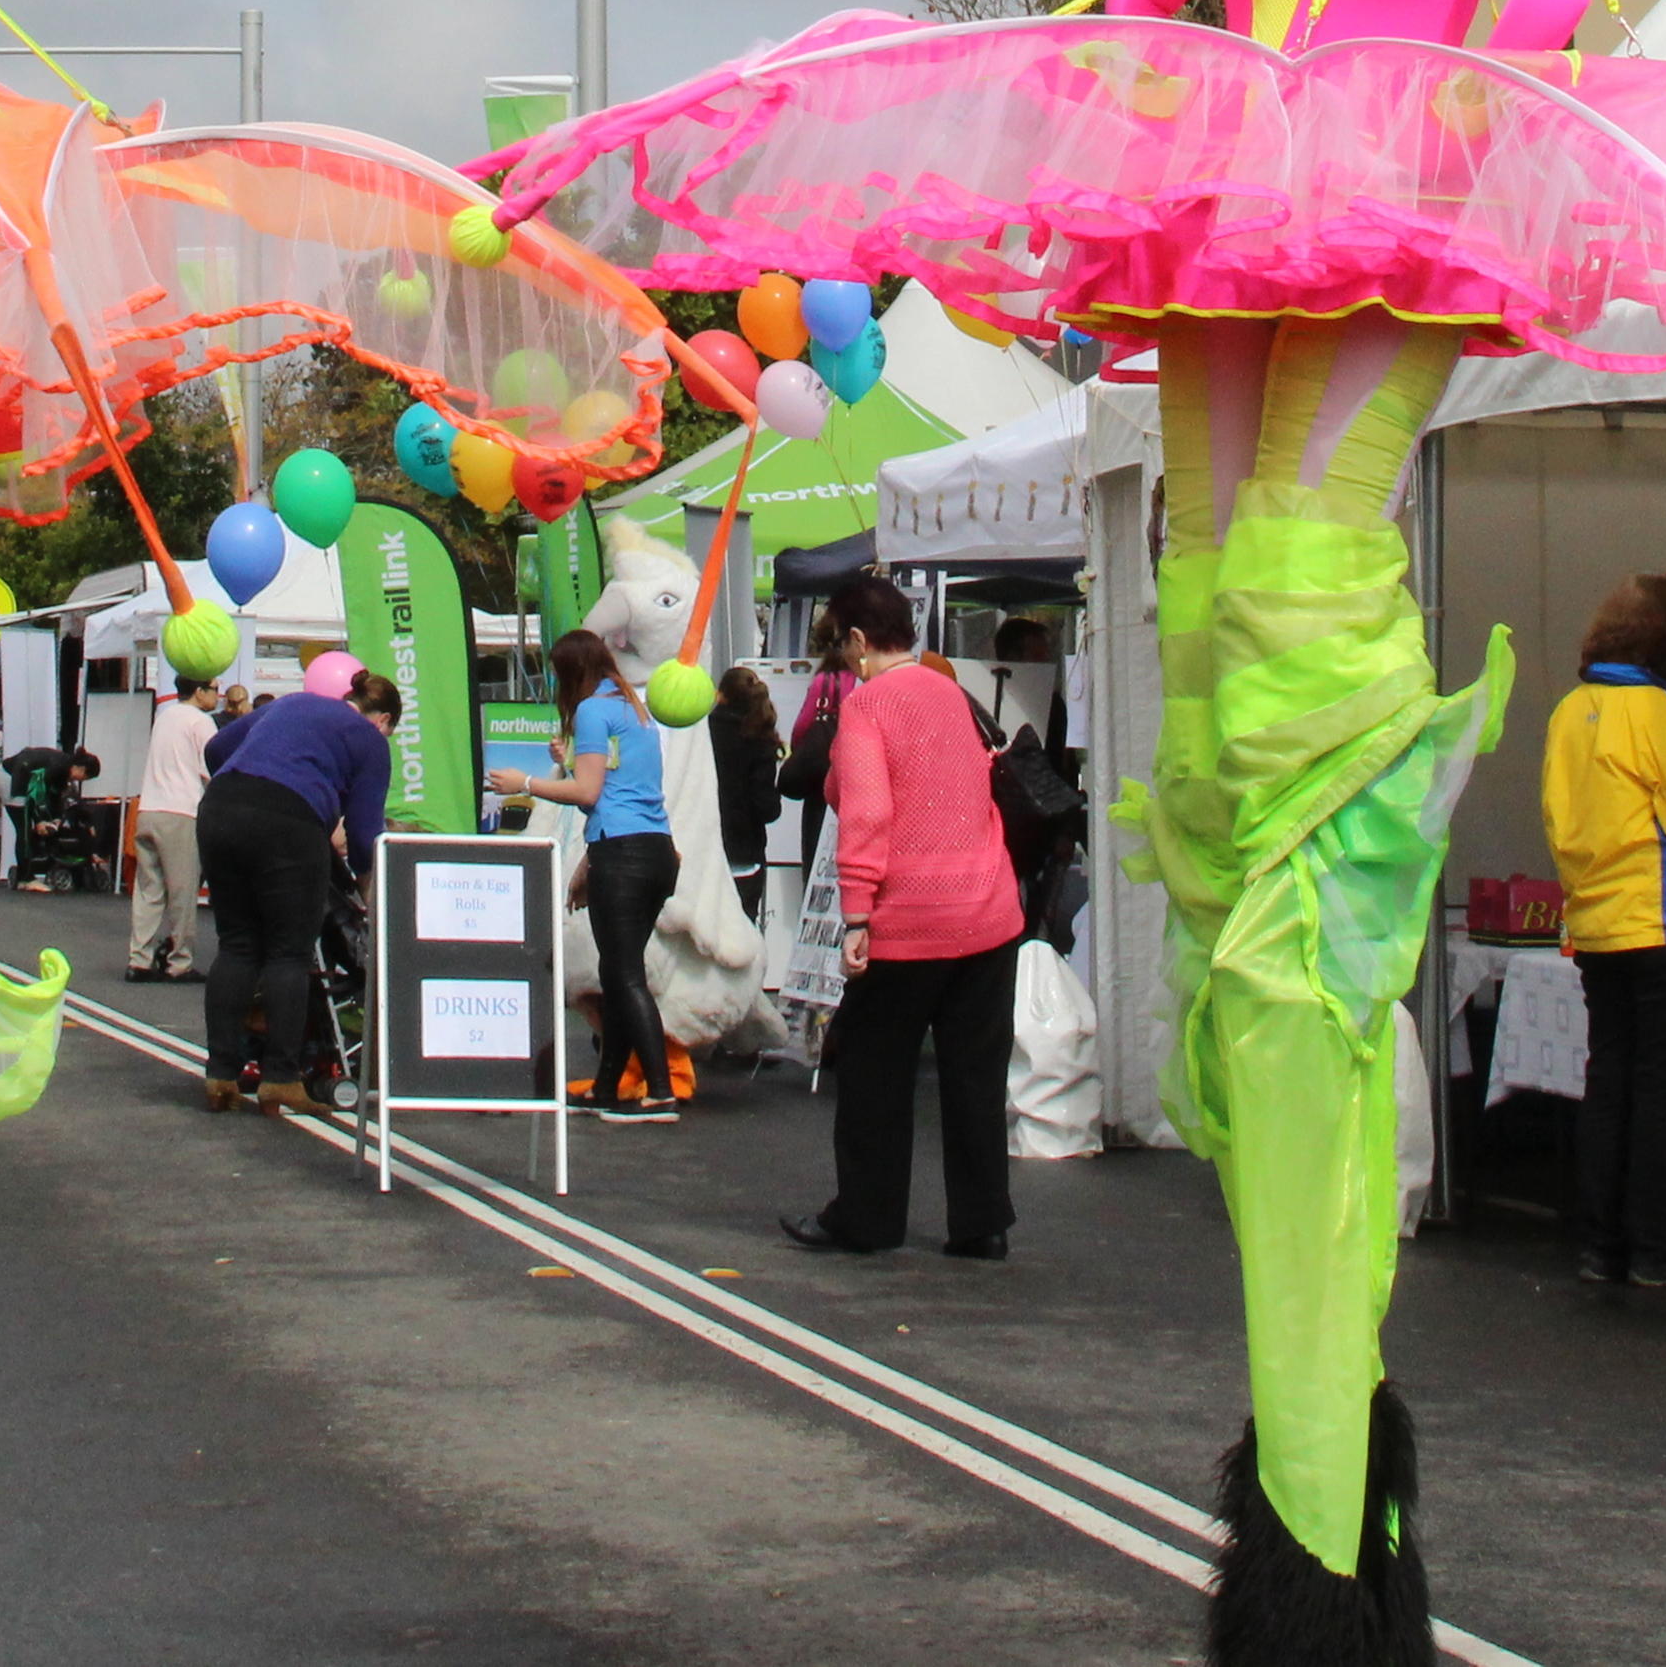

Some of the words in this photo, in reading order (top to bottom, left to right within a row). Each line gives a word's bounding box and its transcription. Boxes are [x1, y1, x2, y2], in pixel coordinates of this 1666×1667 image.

[378, 530, 424, 804] northwestraillink
[431, 878, 470, 890] Bacon
[473, 878, 483, 890] &
[487, 879, 510, 893] Egg
[455, 898, 486, 911] Rolls
[435, 997, 518, 1016] DRINKS
[469, 1029, 484, 1044] $2
